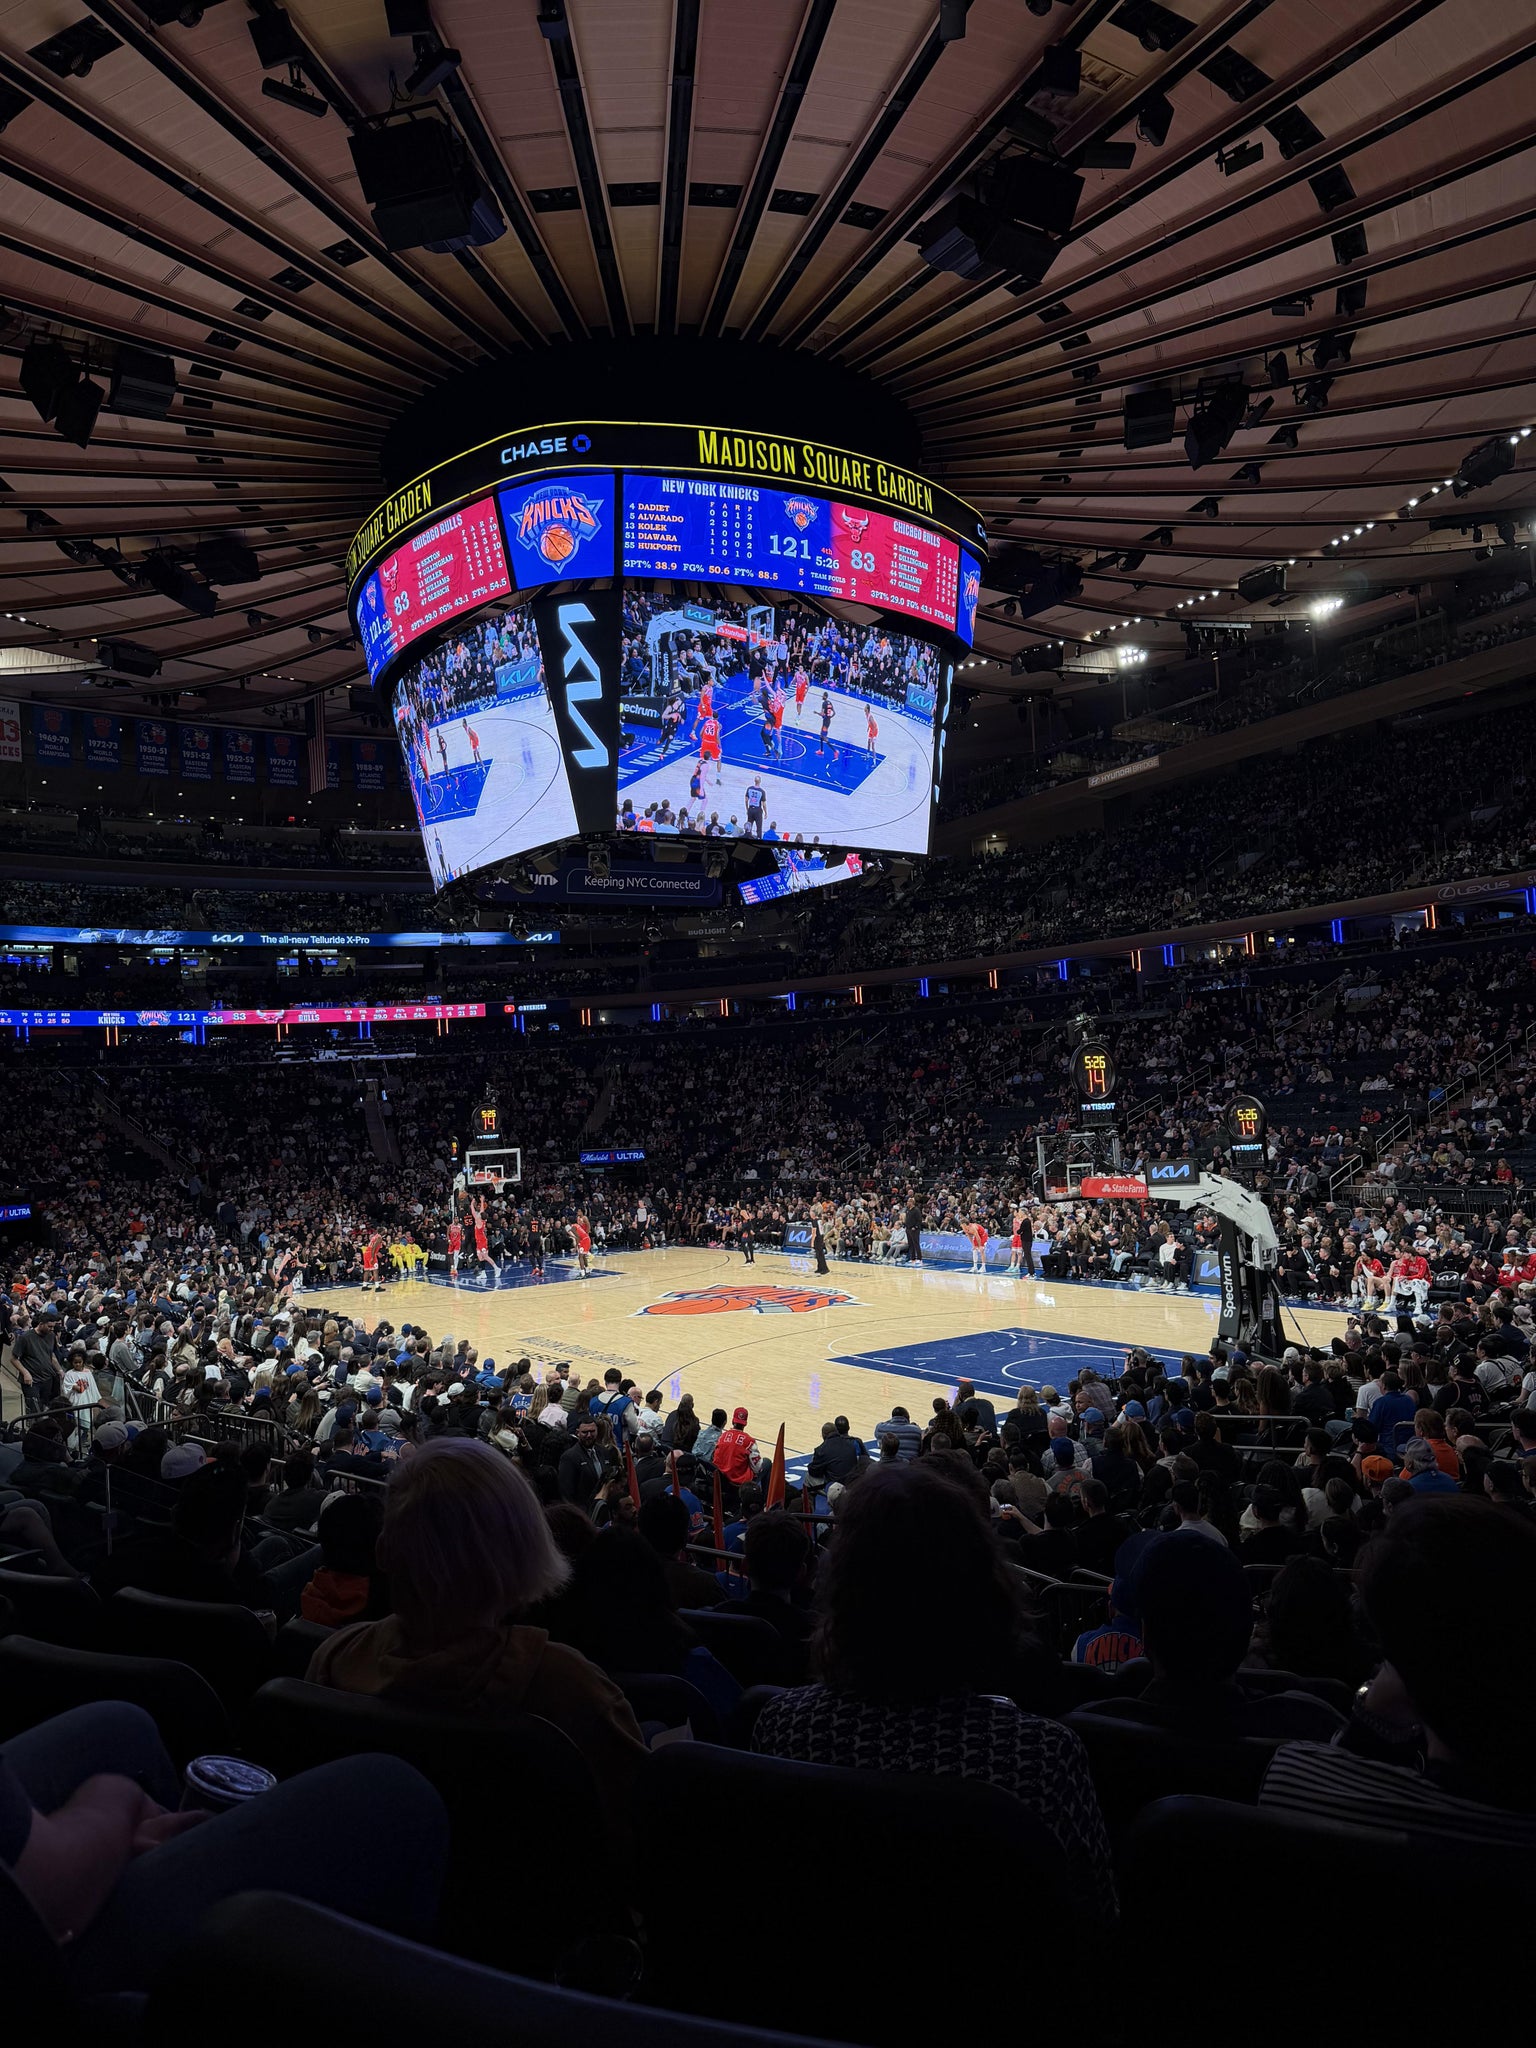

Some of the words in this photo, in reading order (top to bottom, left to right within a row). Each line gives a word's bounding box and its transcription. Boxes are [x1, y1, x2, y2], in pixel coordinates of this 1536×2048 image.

[501, 436, 568, 464] CHASE
[698, 430, 796, 475] MADISON
[802, 444, 873, 493] SQUARE
[877, 463, 933, 514] GARDEN
[662, 479, 685, 494] NEW
[688, 481, 717, 497] YORK
[719, 484, 760, 502] KNICKS
[629, 502, 635, 510] 4
[638, 502, 670, 512] DADIET
[786, 500, 815, 516] KNICKS
[356, 512, 385, 560] SQUARE
[386, 479, 432, 534] GARDEN
[520, 495, 596, 538] KNICKS
[638, 513, 684, 523] ALVARADO
[412, 526, 440, 552] CHICAGO
[440, 514, 463, 536] BULLS
[638, 522, 667, 531] KOLEK
[893, 520, 922, 541] CHICAGO
[922, 529, 941, 548] BULLS
[638, 532, 677, 542] DIAWARA
[638, 542, 681, 552] HUKPORTI
[769, 534, 811, 560] 121
[821, 547, 833, 556] 4th
[815, 555, 840, 570] 5:26
[850, 549, 876, 573] 83
[623, 559, 652, 569] 3PT%
[655, 561, 677, 570] 38.9
[683, 563, 705, 573] FG%
[708, 565, 730, 575] 50.6
[734, 567, 754, 578] FT%
[758, 570, 779, 580] 88.5
[798, 568, 804, 576] 5
[810, 571, 828, 581] TEAM
[828, 574, 846, 584] FOULS
[851, 577, 857, 586] 2
[471, 586, 488, 599] FT%
[489, 577, 507, 591] 54.5
[798, 579, 804, 588] 4
[813, 583, 843, 594] TIMEOUTS
[851, 589, 857, 597] 2
[393, 590, 410, 616] 83
[870, 589, 889, 601] 3PT%
[890, 595, 905, 606] 29.0
[906, 599, 919, 610] FG%
[501, 665, 536, 687] KIA
[88, 739, 119, 750] 1972-73
[139, 744, 168, 755] 1950-51
[226, 753, 255, 764] 1952-53
[269, 757, 297, 767] 1970-71
[1101, 766, 1132, 783] HYUNDAI
[1132, 758, 1159, 773] BRIDGE
[584, 875, 625, 890] Keeping
[626, 876, 648, 888] NYC
[649, 878, 701, 890] Connected
[1457, 879, 1511, 896] LEXUS
[211, 934, 244, 943] KIA
[260, 935, 277, 944] The
[279, 934, 309, 944] all-new
[311, 935, 345, 944] Telluride
[346, 936, 370, 944] X-Pro
[688, 928, 704, 936] BUD
[704, 927, 727, 935] LIGHT
[98, 1016, 126, 1025] KNICKS
[177, 1013, 197, 1021] 121
[202, 1016, 224, 1024] 5:26
[232, 1012, 247, 1021] 83
[297, 1014, 320, 1022] BULLS
[1084, 1056, 1105, 1069] 5:26
[1088, 1069, 1105, 1093] 14
[481, 1109, 496, 1119] 5:26
[1090, 1102, 1115, 1111] TISSOT
[1237, 1108, 1258, 1121] 5:26
[484, 1117, 495, 1131] 14
[1241, 1120, 1255, 1136] 14
[616, 1151, 645, 1160] ULTRA
[1151, 1164, 1190, 1179] KIA
[9, 1207, 31, 1217] ULTRA
[464, 1218, 473, 1226] 55
[1223, 1254, 1235, 1318] Spectrum
[1085, 1632, 1144, 1667] KNICK
